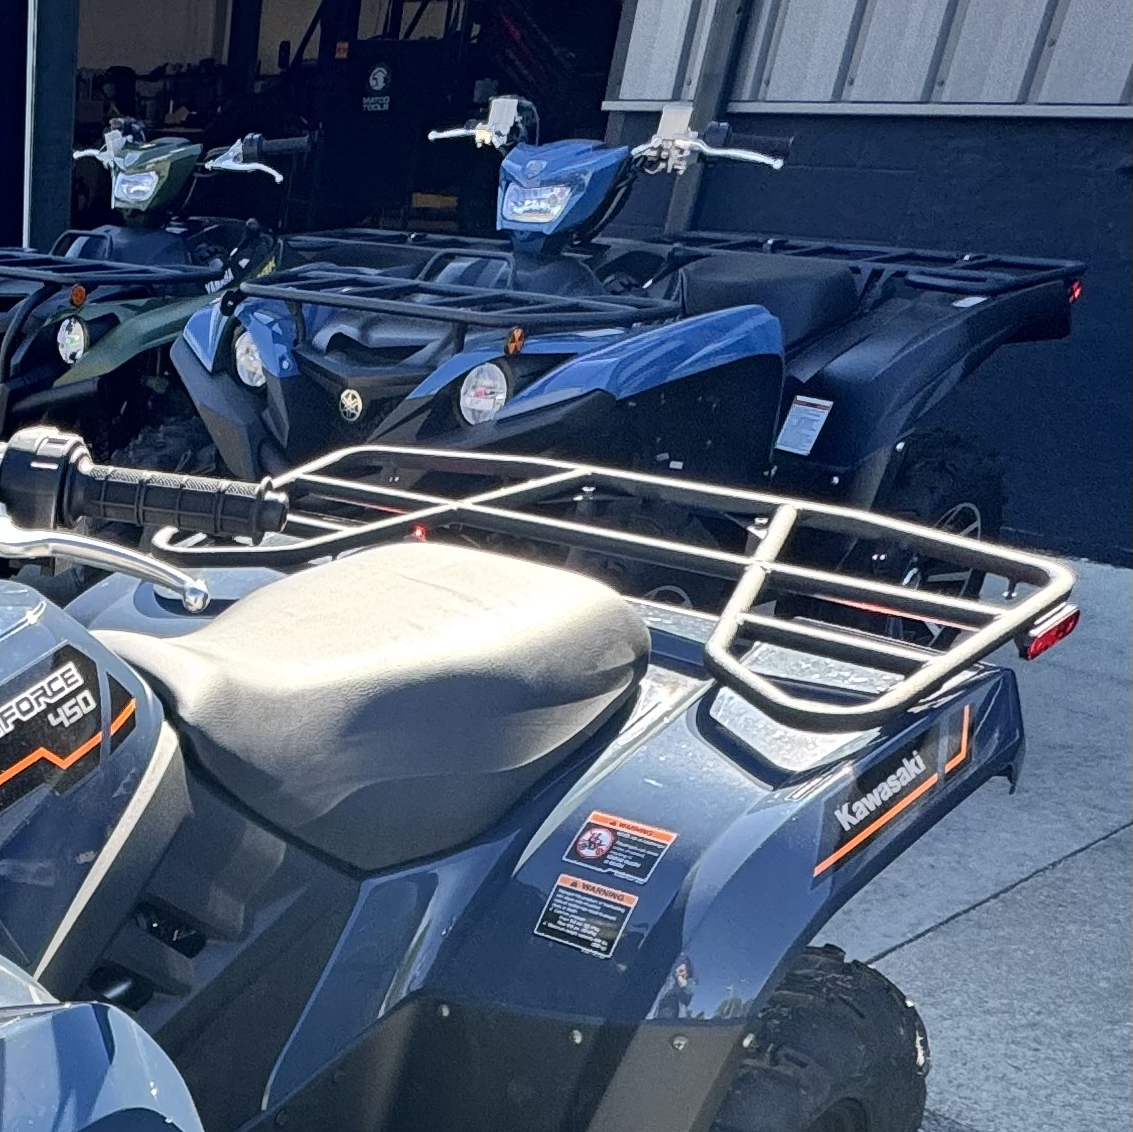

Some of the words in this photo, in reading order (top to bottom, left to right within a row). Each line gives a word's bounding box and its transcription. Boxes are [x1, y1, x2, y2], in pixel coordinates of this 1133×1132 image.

[47, 689, 97, 728] 450
[834, 750, 926, 831] Kawasaki
[582, 882, 625, 902] WARNING
